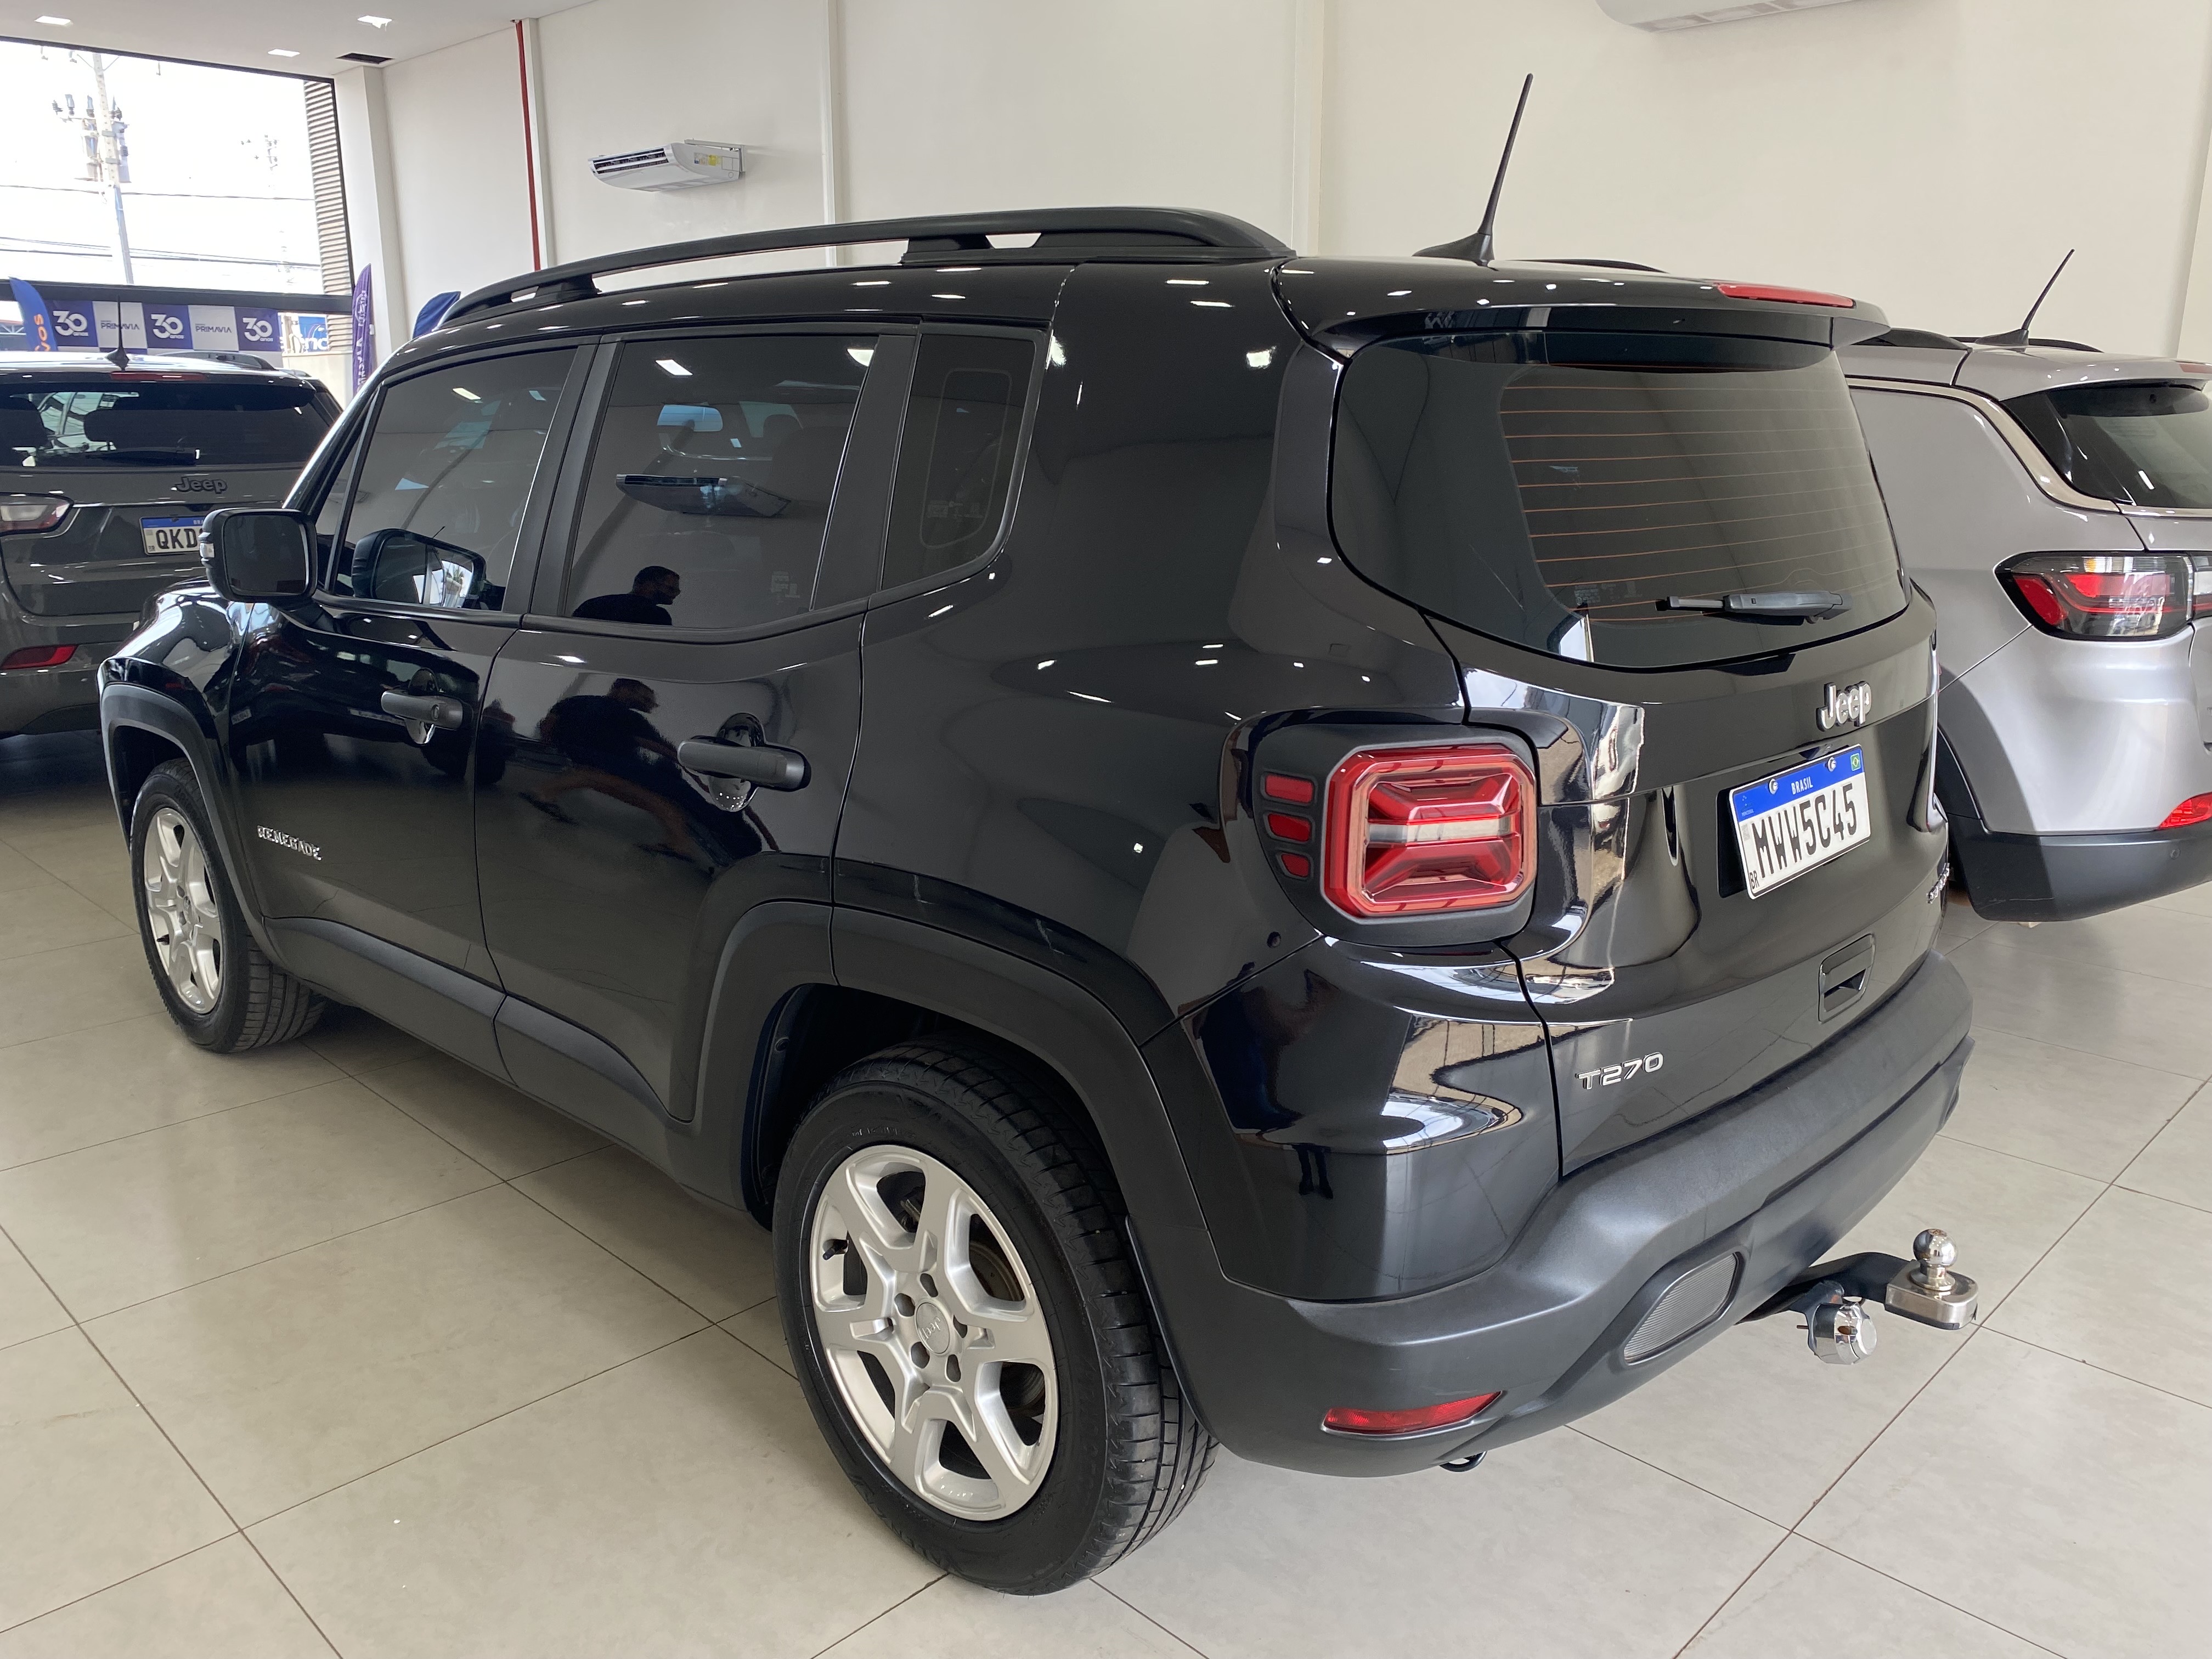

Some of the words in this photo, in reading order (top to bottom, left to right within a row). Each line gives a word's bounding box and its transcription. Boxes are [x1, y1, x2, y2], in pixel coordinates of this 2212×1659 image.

[53, 311, 88, 336] 30
[151, 314, 183, 338] 30
[242, 318, 272, 341] 30
[175, 477, 227, 494] Jeep
[155, 528, 203, 550] QKD
[1816, 681, 1871, 731] Jeep
[1791, 777, 1813, 795] BRASIL
[1752, 782, 1858, 878] MWW5C45
[257, 825, 323, 860] RENEGADE
[1749, 870, 1760, 890] BR
[1575, 1052, 1664, 1090] T270
